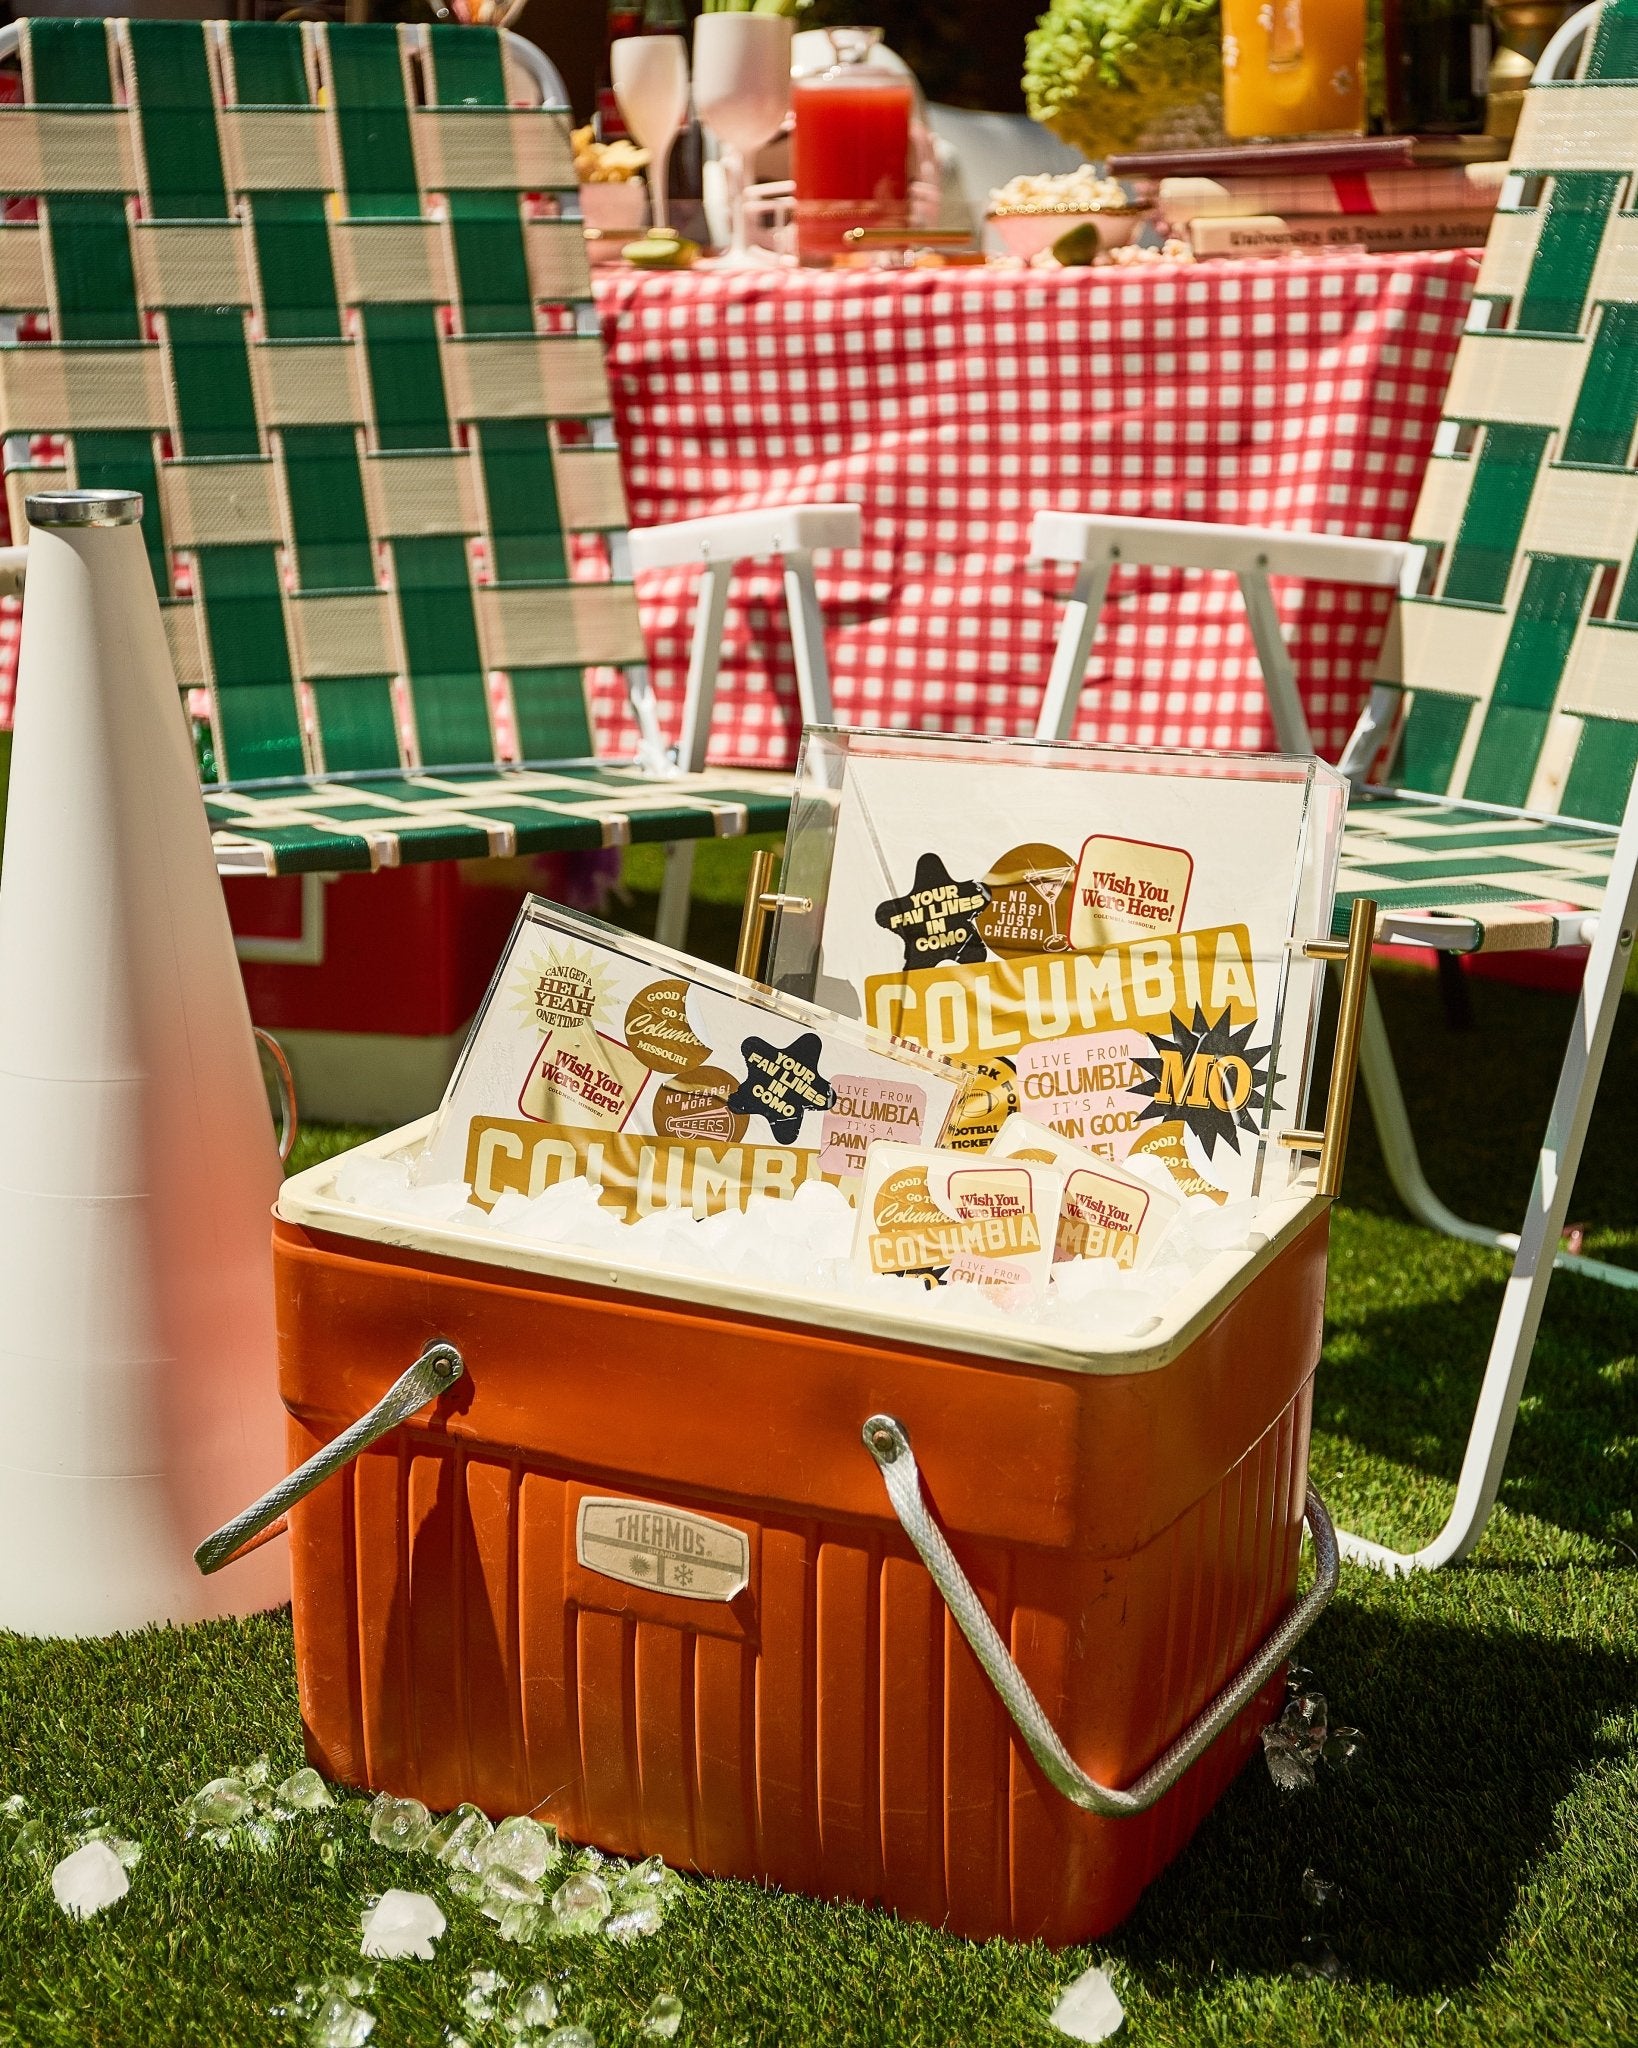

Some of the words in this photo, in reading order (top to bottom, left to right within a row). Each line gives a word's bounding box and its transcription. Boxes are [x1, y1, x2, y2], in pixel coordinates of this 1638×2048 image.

[910, 885, 959, 908] YOUR
[1009, 890, 1027, 902] NO
[1093, 872, 1135, 896] Wish
[1139, 880, 1169, 902] You
[890, 908, 924, 929] FAV
[929, 895, 985, 920] LIVES
[992, 901, 1042, 916] TEARS!
[1081, 888, 1125, 912] Were
[1126, 897, 1175, 922] Here!
[926, 918, 946, 936] IN
[997, 915, 1033, 927] JUST
[1128, 920, 1156, 930] MISSOURI
[916, 928, 967, 951] COMO
[984, 924, 1044, 941] CHEERS!
[545, 966, 565, 978] CAN
[564, 966, 569, 978] I
[569, 967, 588, 982] GET
[586, 977, 592, 986] A
[537, 976, 596, 1002] HELL
[647, 991, 680, 1002] GOOD
[875, 932, 1256, 1056] COLUMBIA
[534, 990, 594, 1017] YEAH
[661, 1006, 677, 1018] GO
[536, 1008, 557, 1025] ONE
[556, 1014, 584, 1028] TIME
[625, 1013, 704, 1047] Columb
[637, 1040, 688, 1066] MISSOURI
[1030, 1053, 1071, 1069] LIVE
[1087, 1044, 1129, 1062] FROM
[555, 1050, 593, 1082] Wish
[594, 1070, 623, 1097] You
[776, 1052, 816, 1084] YOUR
[541, 1061, 579, 1092] Were
[579, 1082, 625, 1115] Here!
[748, 1052, 781, 1077] FAV
[779, 1071, 827, 1107] LIVES
[768, 1080, 789, 1098] IN
[1024, 1061, 1146, 1100] COLUMBIA
[1155, 1050, 1253, 1113] MO
[666, 1094, 680, 1105] NO
[687, 1084, 731, 1101] TEARS!
[752, 1084, 796, 1117] COMO
[837, 1084, 869, 1098] LIVE
[880, 1090, 913, 1104] FROM
[977, 1065, 1000, 1080] RK
[1001, 1080, 1017, 1116] FOR
[578, 1101, 603, 1117] MISSOURI
[681, 1098, 712, 1112] MORE
[829, 1096, 920, 1127] COLUMBIA
[1052, 1098, 1091, 1115] IT'S
[1106, 1096, 1115, 1108] A
[675, 1119, 724, 1133] CHEERS
[847, 1120, 876, 1134] IT'S
[886, 1126, 894, 1137] A
[1048, 1118, 1084, 1139] AMN
[1090, 1110, 1141, 1136] GOOD
[830, 1131, 868, 1150] DAMN
[951, 1137, 994, 1149] TICKET
[1141, 1136, 1177, 1154] GOOD
[1162, 1156, 1180, 1168] GO
[474, 1127, 860, 1222] COLUMB
[890, 1177, 921, 1192] GOOD
[906, 1193, 925, 1202] GO
[960, 1193, 993, 1207] Wish
[993, 1194, 1019, 1206] You
[1076, 1193, 1106, 1214] Wish
[1108, 1204, 1130, 1222] You
[876, 1202, 956, 1227] Columb
[957, 1207, 989, 1220] Were
[989, 1206, 1025, 1218] Here!
[1067, 1203, 1097, 1223] Were
[873, 1215, 1041, 1269] COLUMBIA
[1060, 1221, 1136, 1267] MBIA
[960, 1260, 985, 1272] LIVE
[994, 1268, 1021, 1280] FROM
